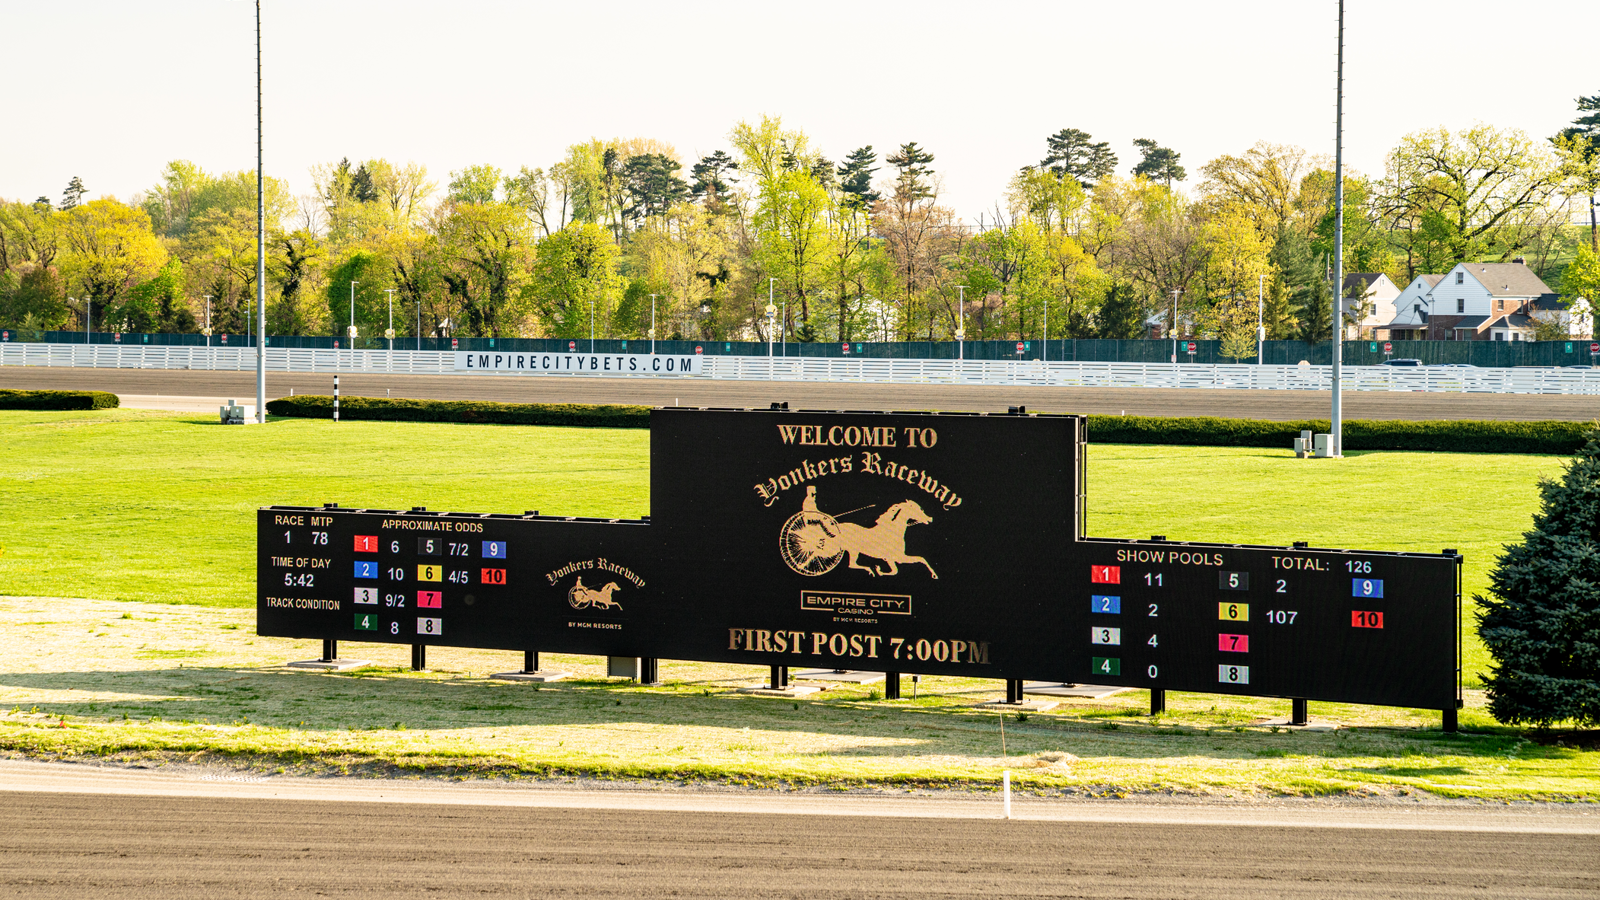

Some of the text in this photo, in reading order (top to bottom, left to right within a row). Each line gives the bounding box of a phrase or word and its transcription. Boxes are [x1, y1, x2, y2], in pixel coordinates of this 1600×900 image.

[467, 354, 692, 372] EMPIRECITYBETS.COM
[777, 425, 937, 448] WELCOME TO
[753, 452, 963, 511] Yonkers Raceway
[275, 515, 333, 526] RACE MTP
[382, 519, 483, 533] APPROXIMATE ODDS
[285, 531, 328, 545] 1 78
[363, 538, 399, 553] 1 6
[426, 540, 468, 556] 5 7/2
[490, 543, 498, 556] 9
[271, 557, 331, 568] TIME OF DAY
[1117, 550, 1223, 566] SHOW POOLS
[1272, 556, 1371, 573] TOTAL: 126
[284, 573, 314, 587] 5:42
[362, 563, 404, 581] 2 10
[425, 567, 468, 584] 6 4/5
[486, 570, 502, 583] 10
[545, 557, 646, 589] Yonkers Raceway
[1102, 567, 1162, 586] 1 11
[1229, 574, 1286, 593] 5 2
[1362, 580, 1373, 595] 9
[266, 597, 340, 610] TRACK CONDITION
[362, 590, 404, 607] 3 9/2
[426, 593, 434, 606] 7
[807, 596, 904, 608] EMPIRE CITY
[1101, 598, 1158, 617] 2 2
[1228, 605, 1298, 624] 6 107
[361, 616, 399, 634] 4 8
[425, 620, 433, 633] 8
[1357, 612, 1378, 627] 10
[728, 629, 991, 665] FIRST POST 7:00PM
[1101, 630, 1158, 648] 3 4
[1229, 636, 1239, 650] 7
[1101, 660, 1158, 678] 4 0
[1229, 667, 1238, 682] 8
